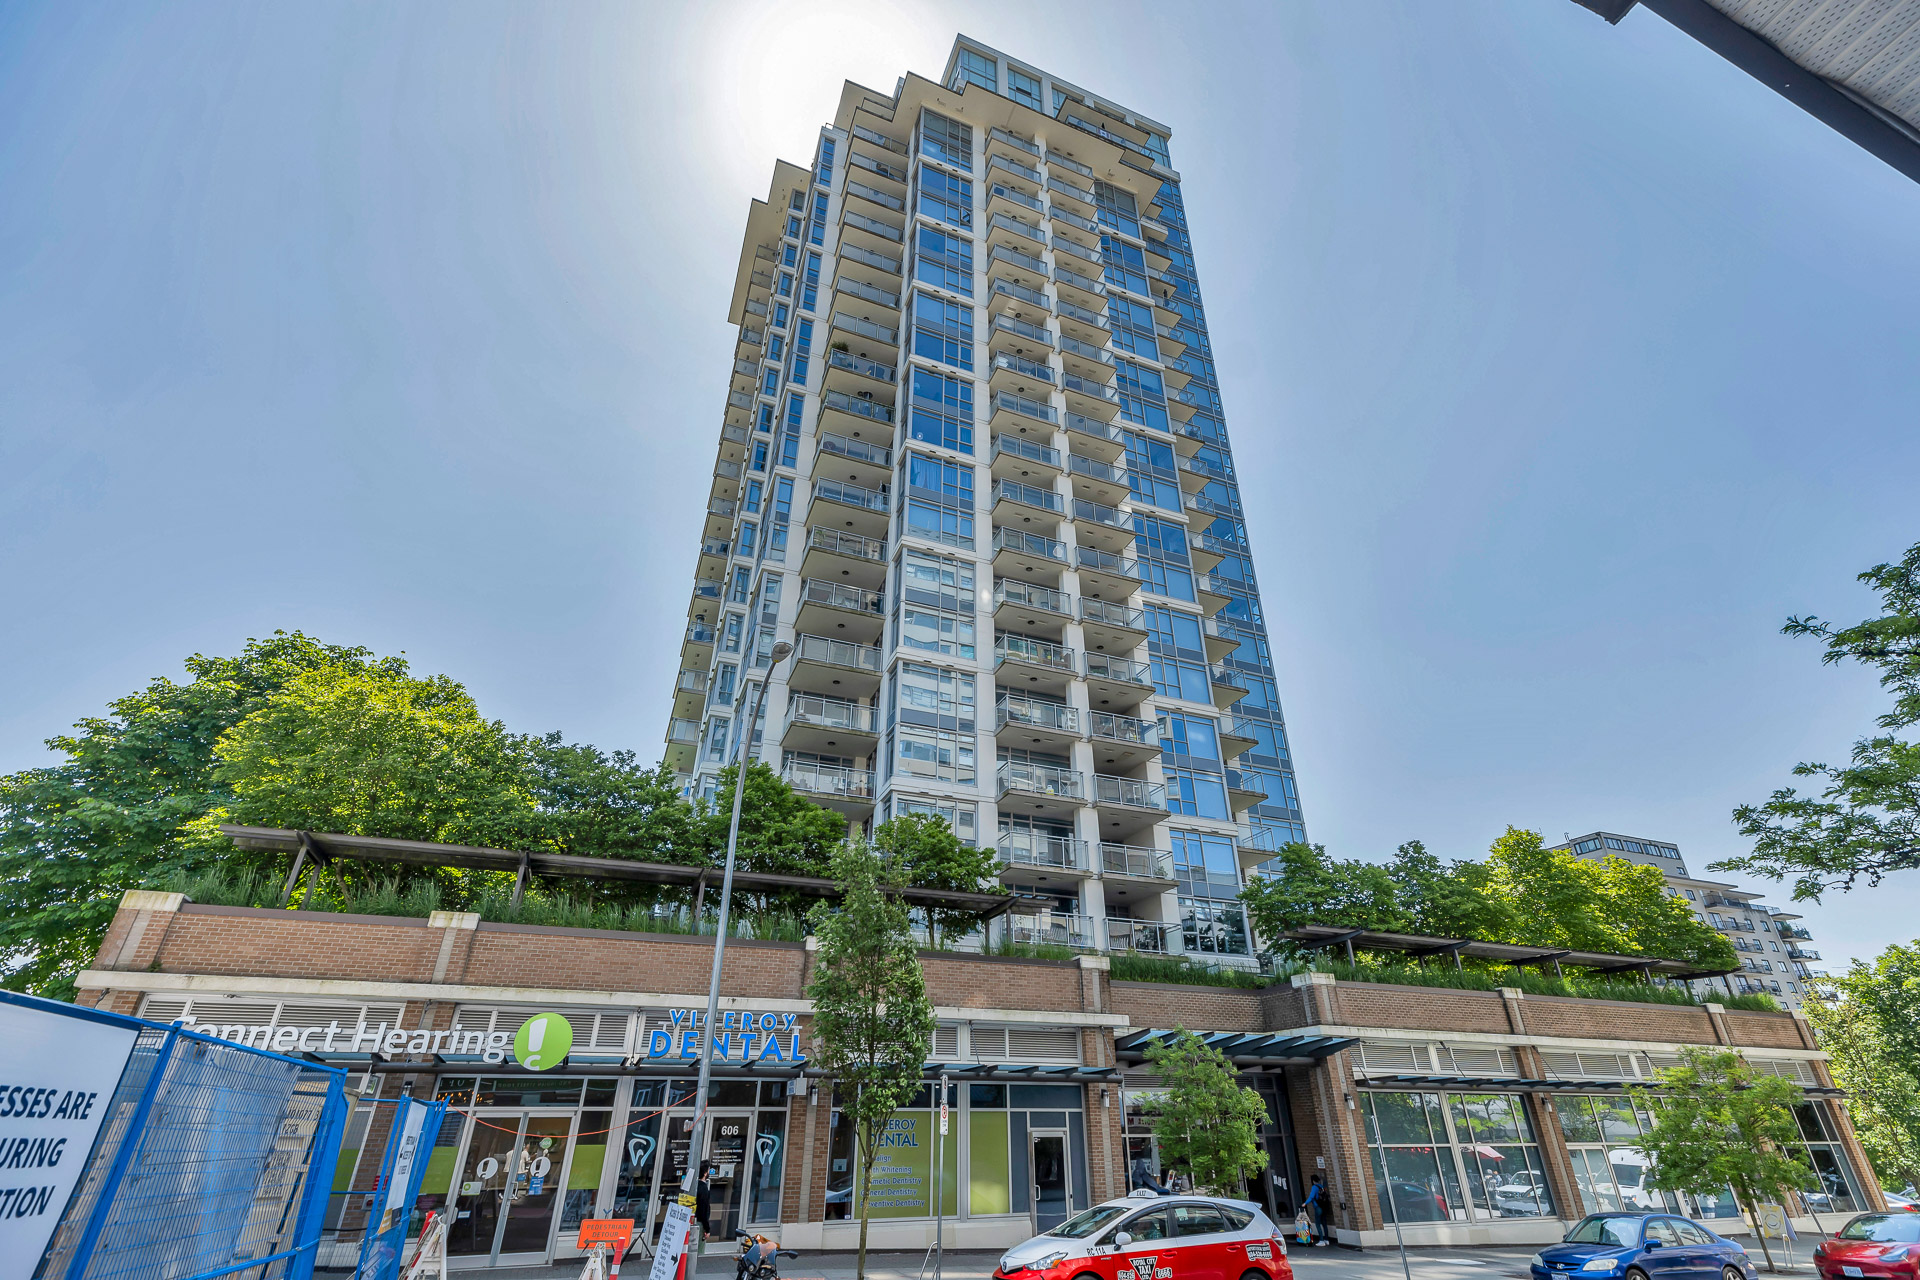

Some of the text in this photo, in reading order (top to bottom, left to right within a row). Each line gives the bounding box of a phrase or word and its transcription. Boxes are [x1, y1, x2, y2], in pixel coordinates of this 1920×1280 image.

[669, 1009, 797, 1033] VIEROY
[352, 1021, 510, 1064] Hearing
[647, 1030, 806, 1062] DENTAL
[52, 1090, 98, 1120] ARE
[721, 1125, 739, 1135] 606
[872, 1119, 917, 1131] VEROY
[861, 1166, 913, 1175] Tth Whitening
[892, 1177, 922, 1186] Dentistry
[860, 1188, 918, 1197] Gneral Dentistry
[0, 1185, 56, 1220] TION
[895, 1199, 926, 1208] Dentistry
[1138, 1265, 1151, 1275] TAXI
